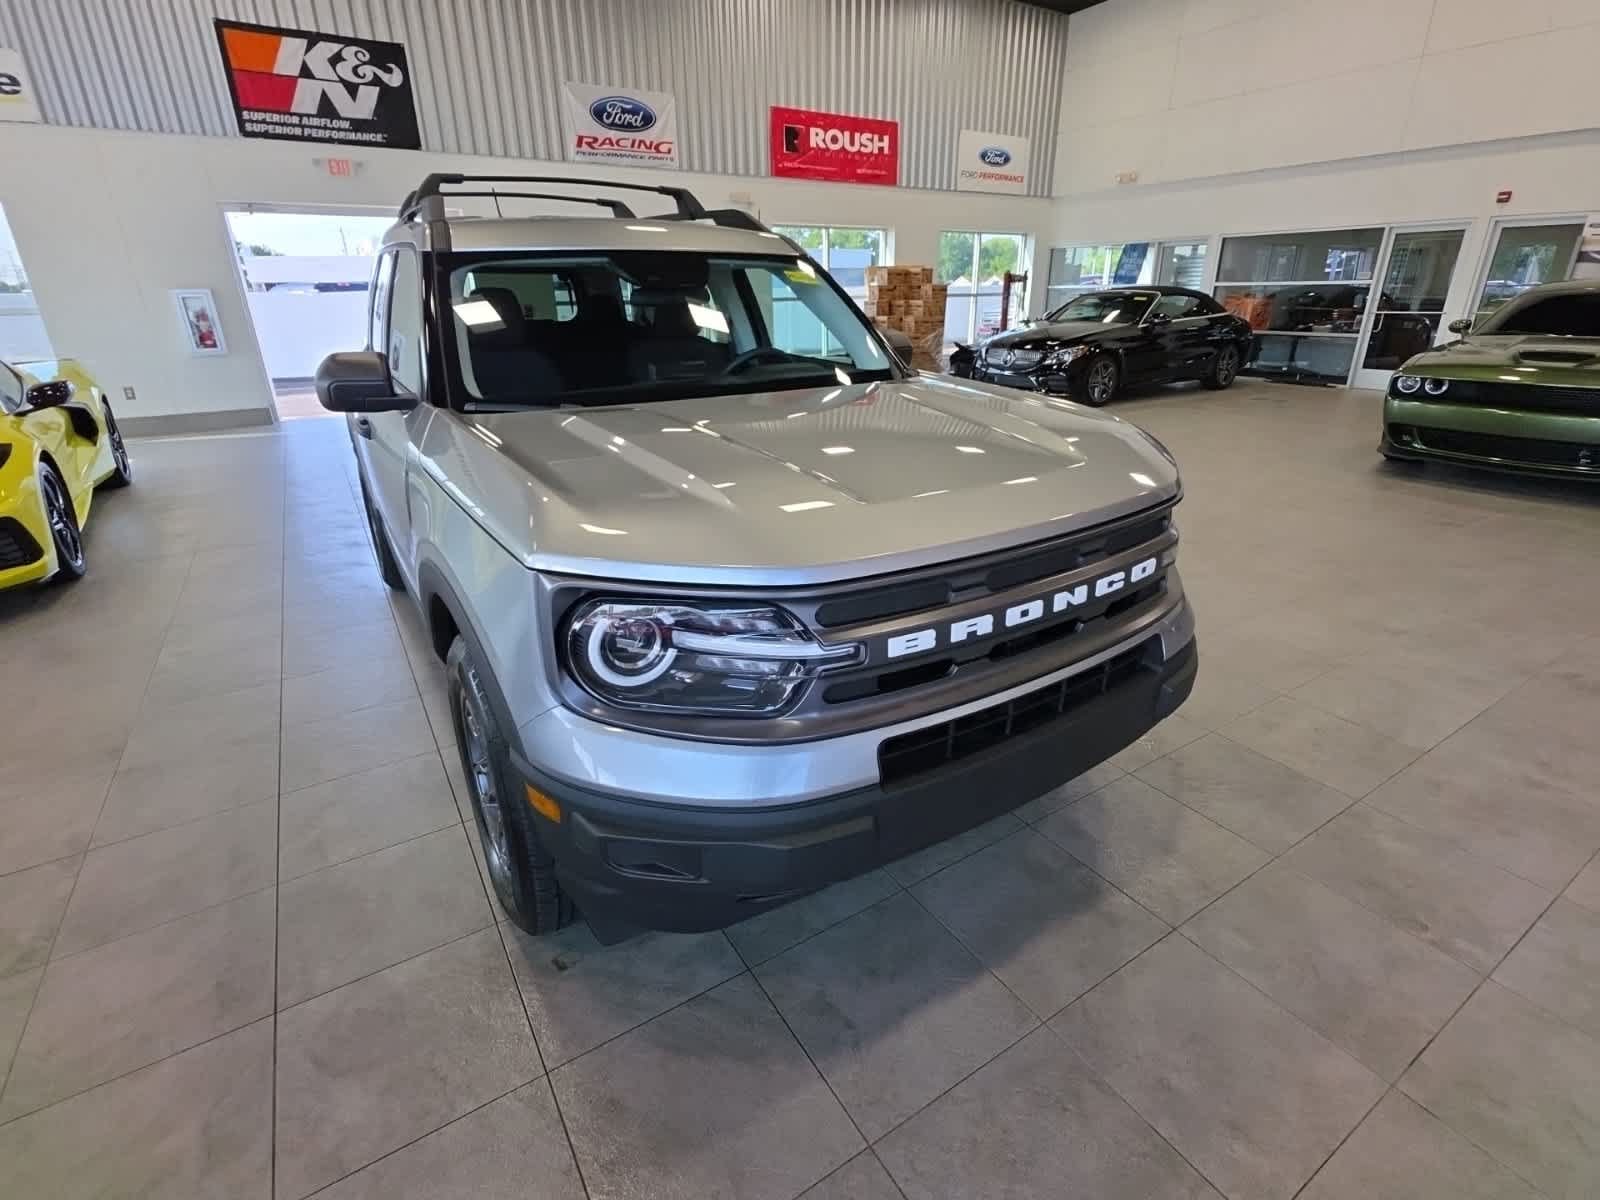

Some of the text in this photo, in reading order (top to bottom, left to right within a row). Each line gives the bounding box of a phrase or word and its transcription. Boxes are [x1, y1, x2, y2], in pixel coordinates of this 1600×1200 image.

[242, 111, 353, 130] SUPERIOR AIRFLOW.
[603, 101, 644, 127] Ford
[245, 122, 302, 136] SUPERIOR
[576, 134, 673, 154] RACING
[809, 127, 890, 155] ROUSH
[985, 150, 1005, 164] Ford
[327, 159, 351, 176] EXIT
[976, 171, 1024, 183] PERFORMANCE
[887, 557, 1158, 658] BRONCO
